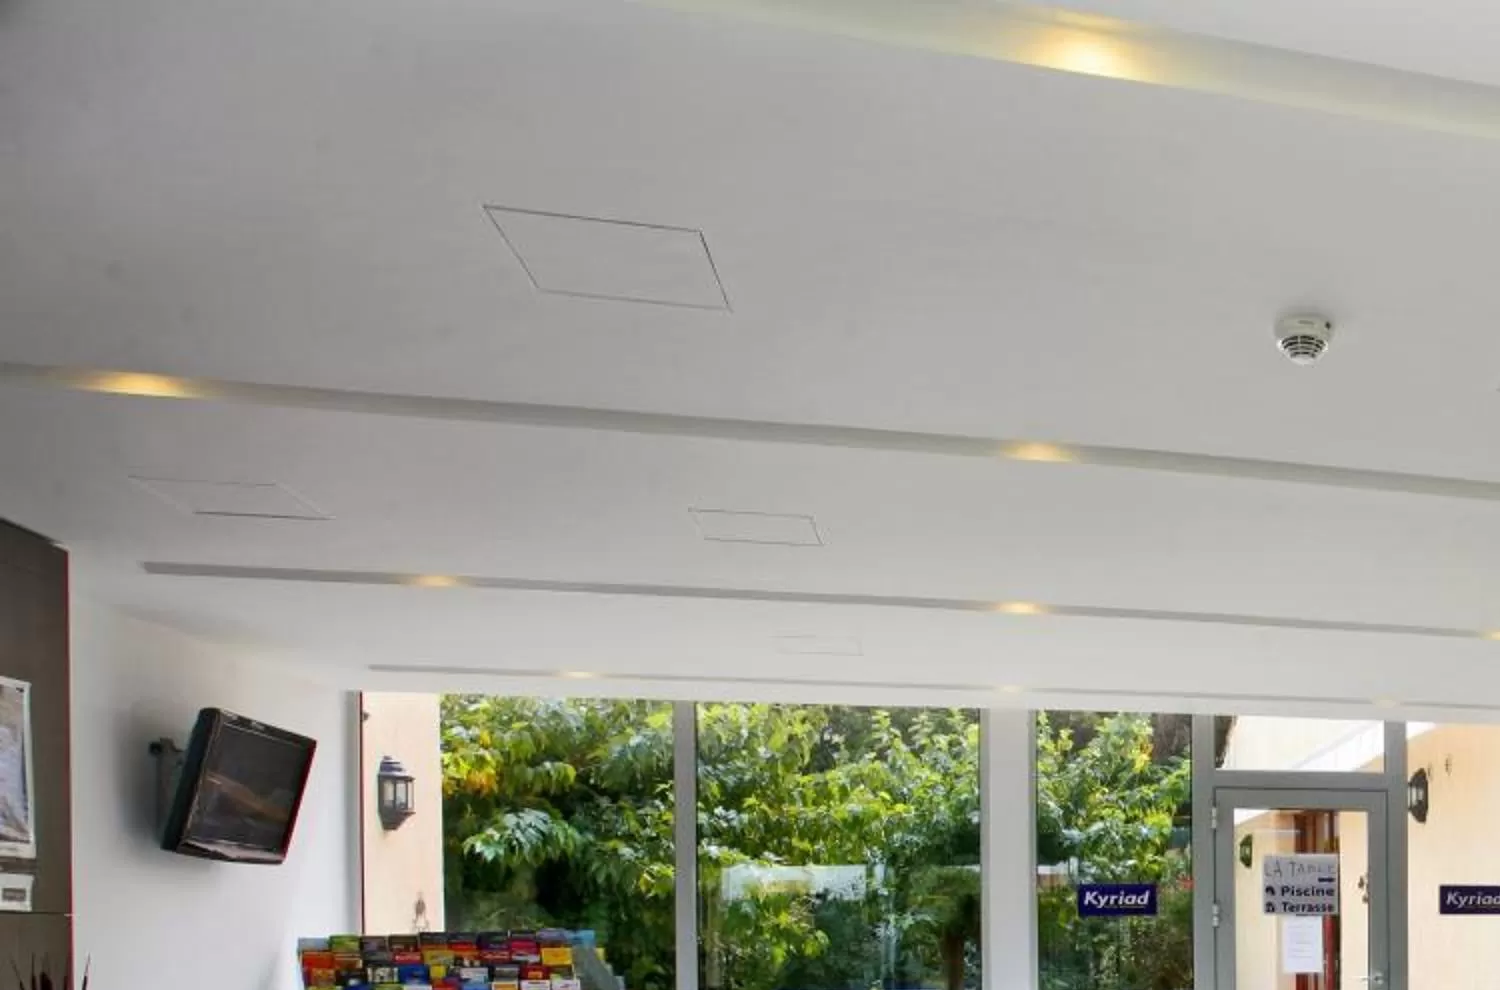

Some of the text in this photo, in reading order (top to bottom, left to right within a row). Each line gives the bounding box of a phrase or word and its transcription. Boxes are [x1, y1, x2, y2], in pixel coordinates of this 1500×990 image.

[1281, 886, 1335, 897] Piscine
[1083, 889, 1151, 909] Kyriad
[1282, 901, 1335, 913] Terrasse
